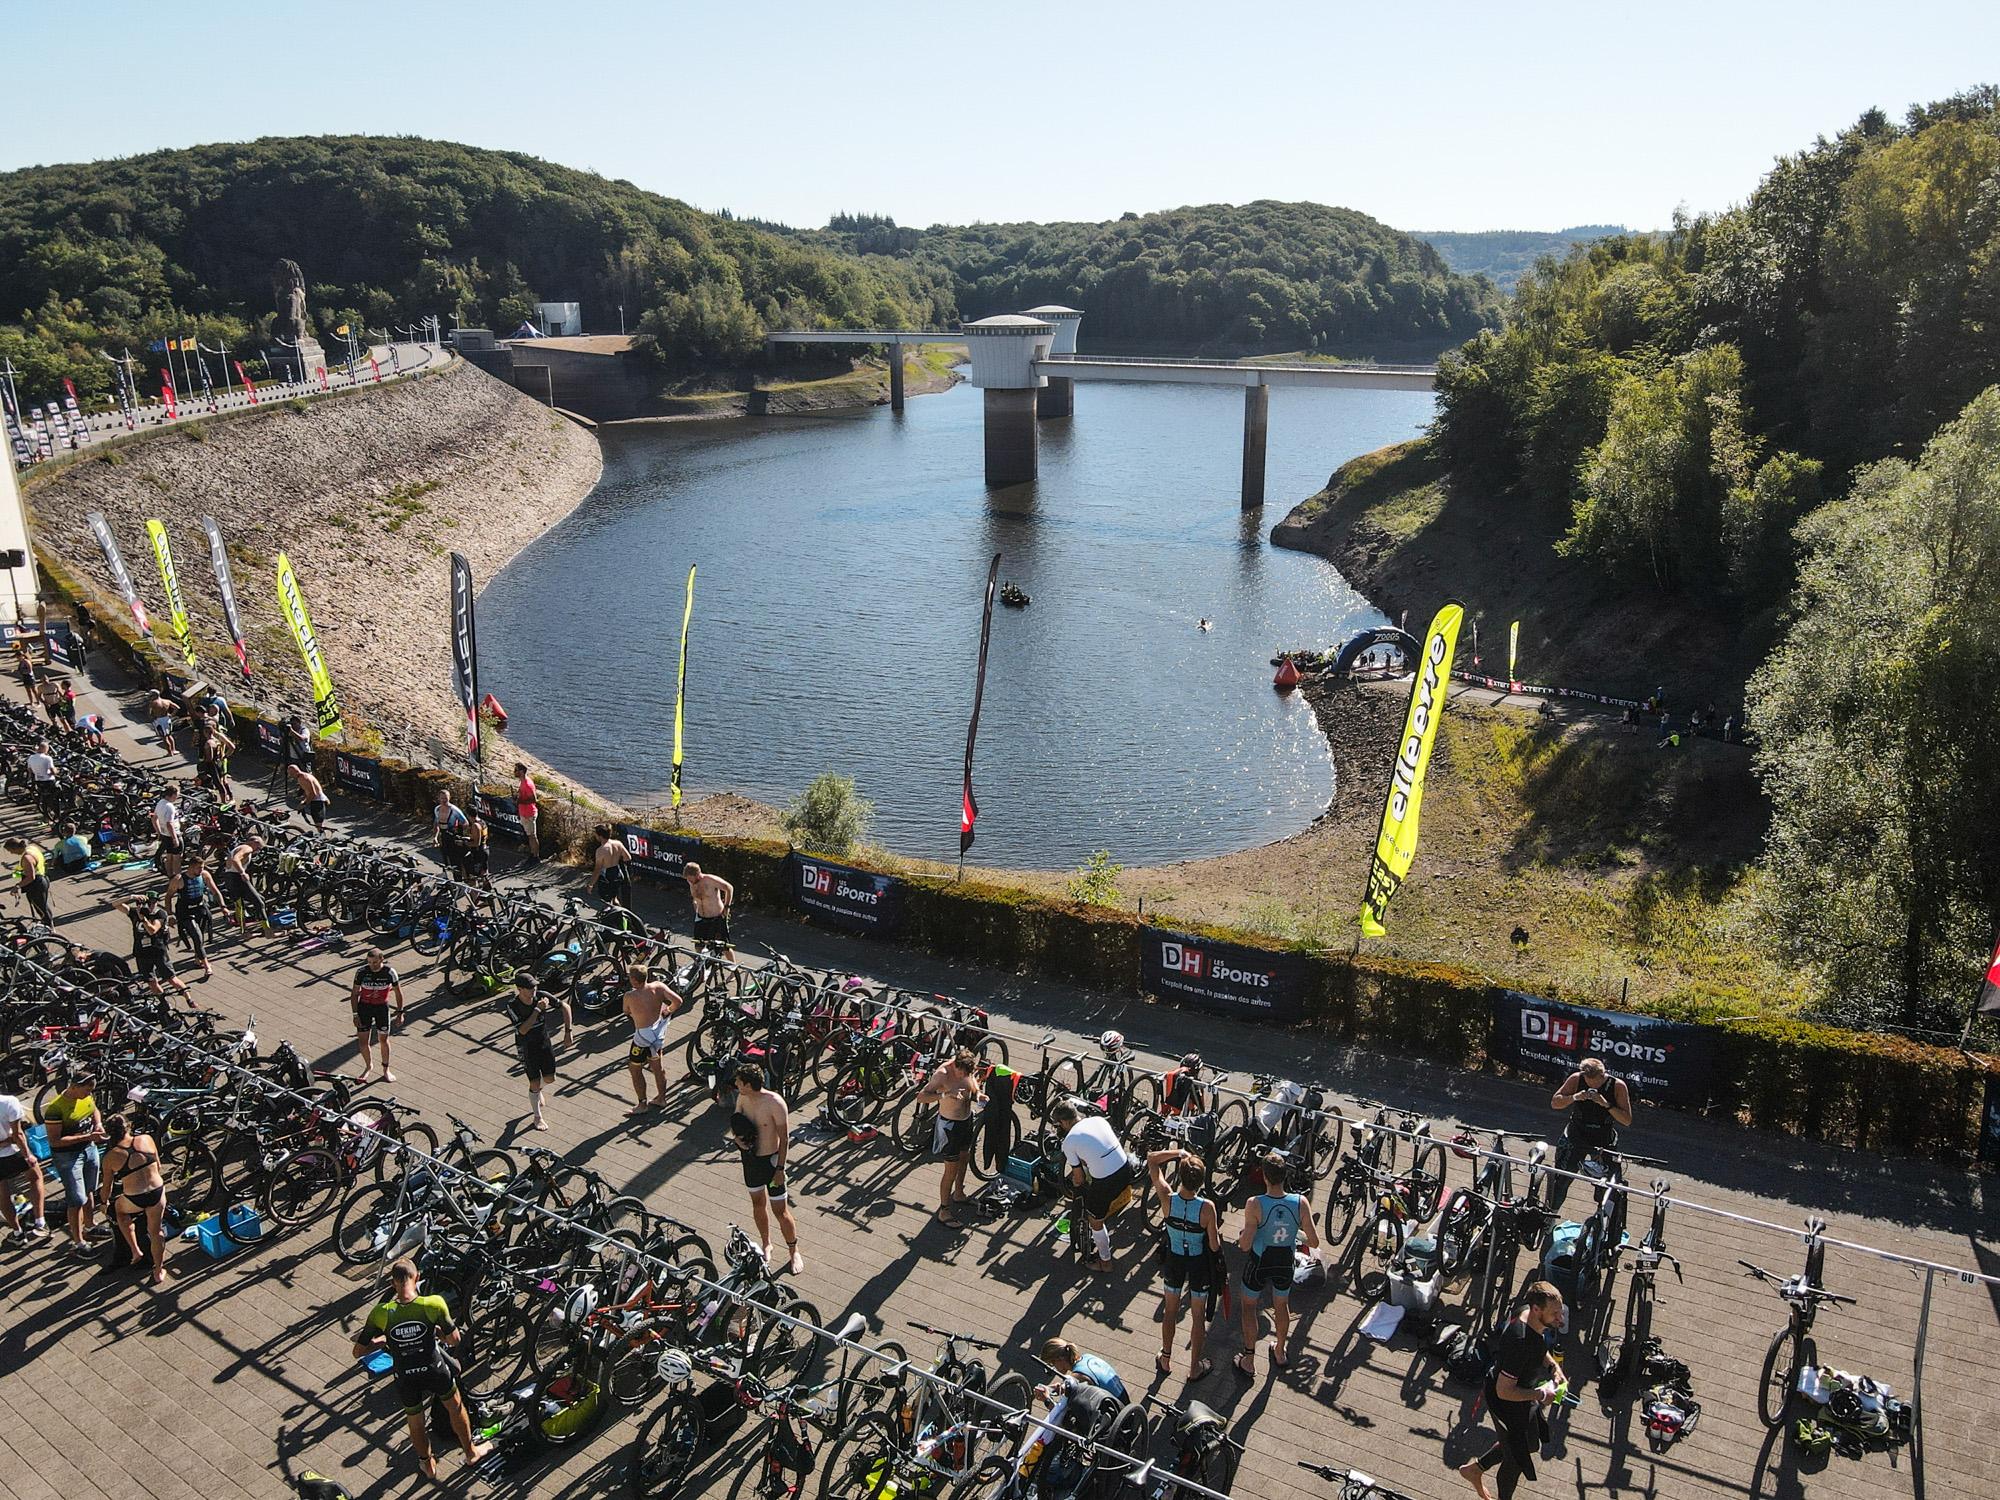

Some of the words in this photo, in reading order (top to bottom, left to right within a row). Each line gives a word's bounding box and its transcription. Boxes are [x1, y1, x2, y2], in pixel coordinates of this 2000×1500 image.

[1391, 632, 1447, 823] elleerre
[628, 834, 648, 857] DH
[654, 850, 683, 864] SPORTS
[803, 866, 830, 892] DH
[836, 886, 878, 905] SPORTS
[1164, 943, 1200, 974] DH
[1212, 965, 1270, 988] SPORTS
[1523, 1011, 1573, 1046] DH
[1590, 1037, 1666, 1064] SPORTS
[1592, 1029, 1607, 1038] LES
[1659, 1198, 1670, 1209] 62
[1961, 1272, 1975, 1284] 60
